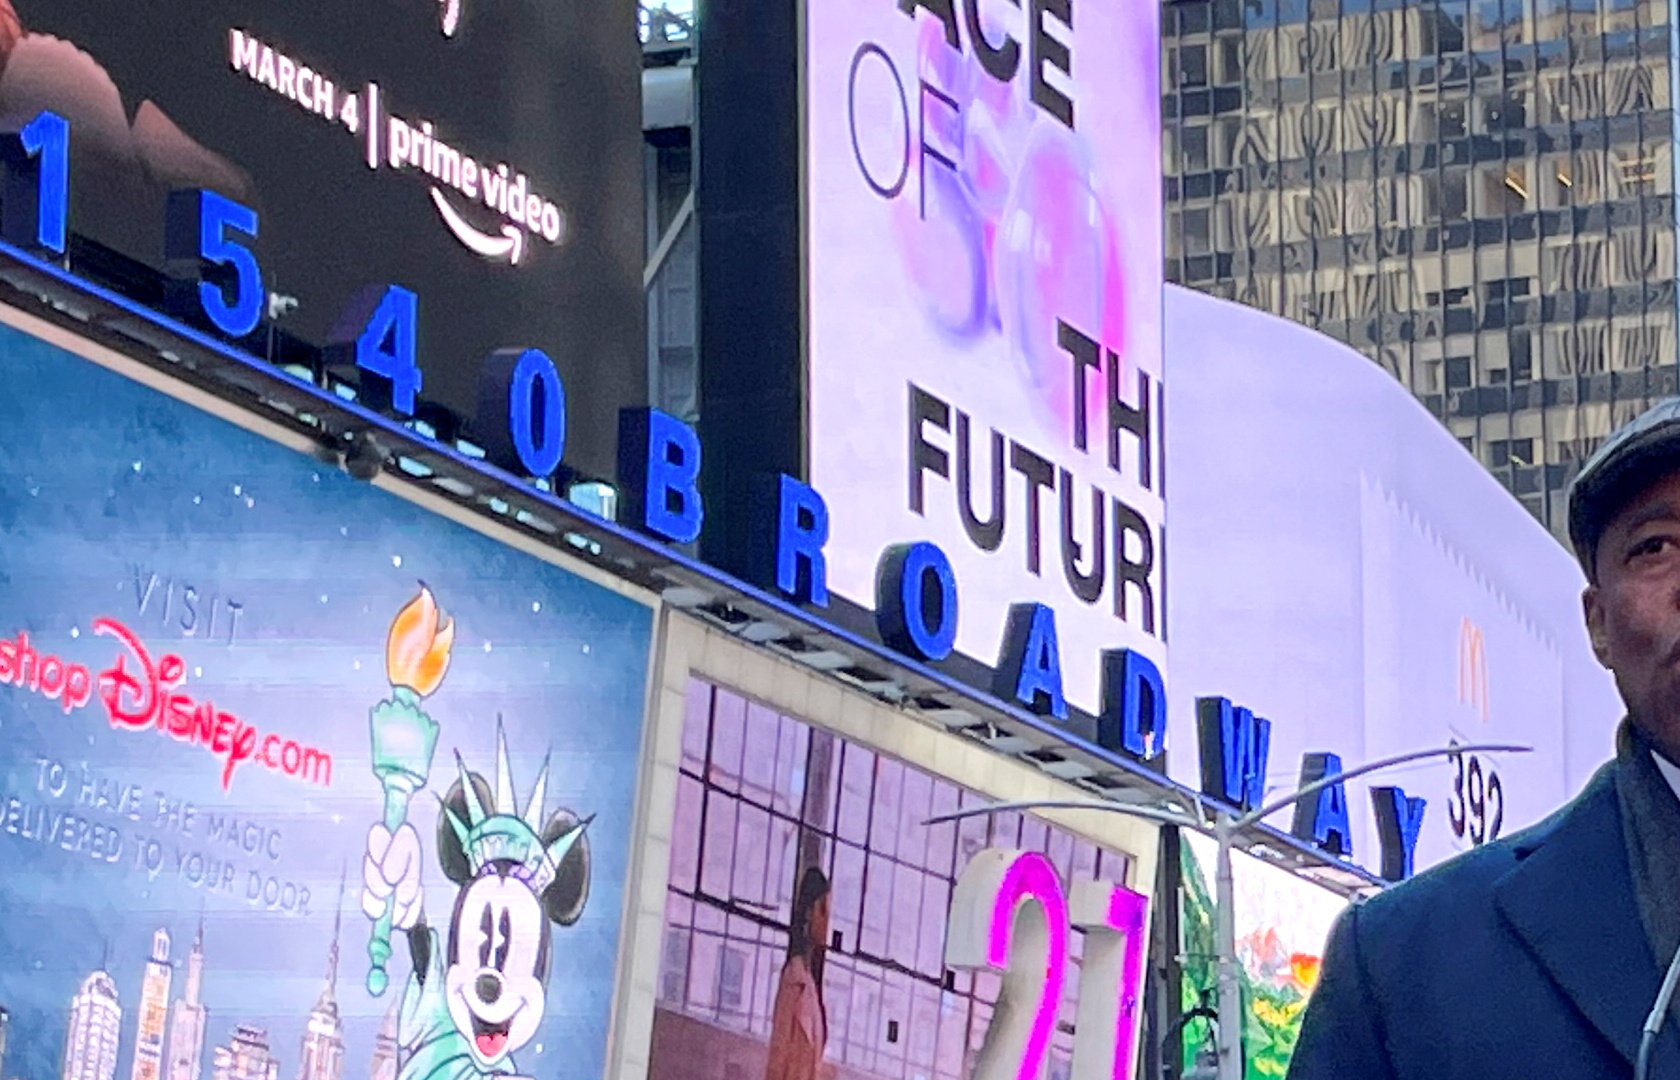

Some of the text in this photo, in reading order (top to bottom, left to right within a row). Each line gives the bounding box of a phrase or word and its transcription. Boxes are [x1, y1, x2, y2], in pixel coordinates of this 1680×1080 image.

[230, 29, 359, 132] MARCH 4
[849, 42, 959, 220] OF
[388, 116, 560, 241] prime video
[1057, 317, 1166, 499] TH
[908, 379, 1167, 644] FUTUR
[128, 563, 243, 645] VISIT
[207, 812, 282, 860] MAGIC
[1447, 738, 1503, 846] 392
[175, 847, 237, 892] YOUR
[246, 871, 312, 916] DOOR
